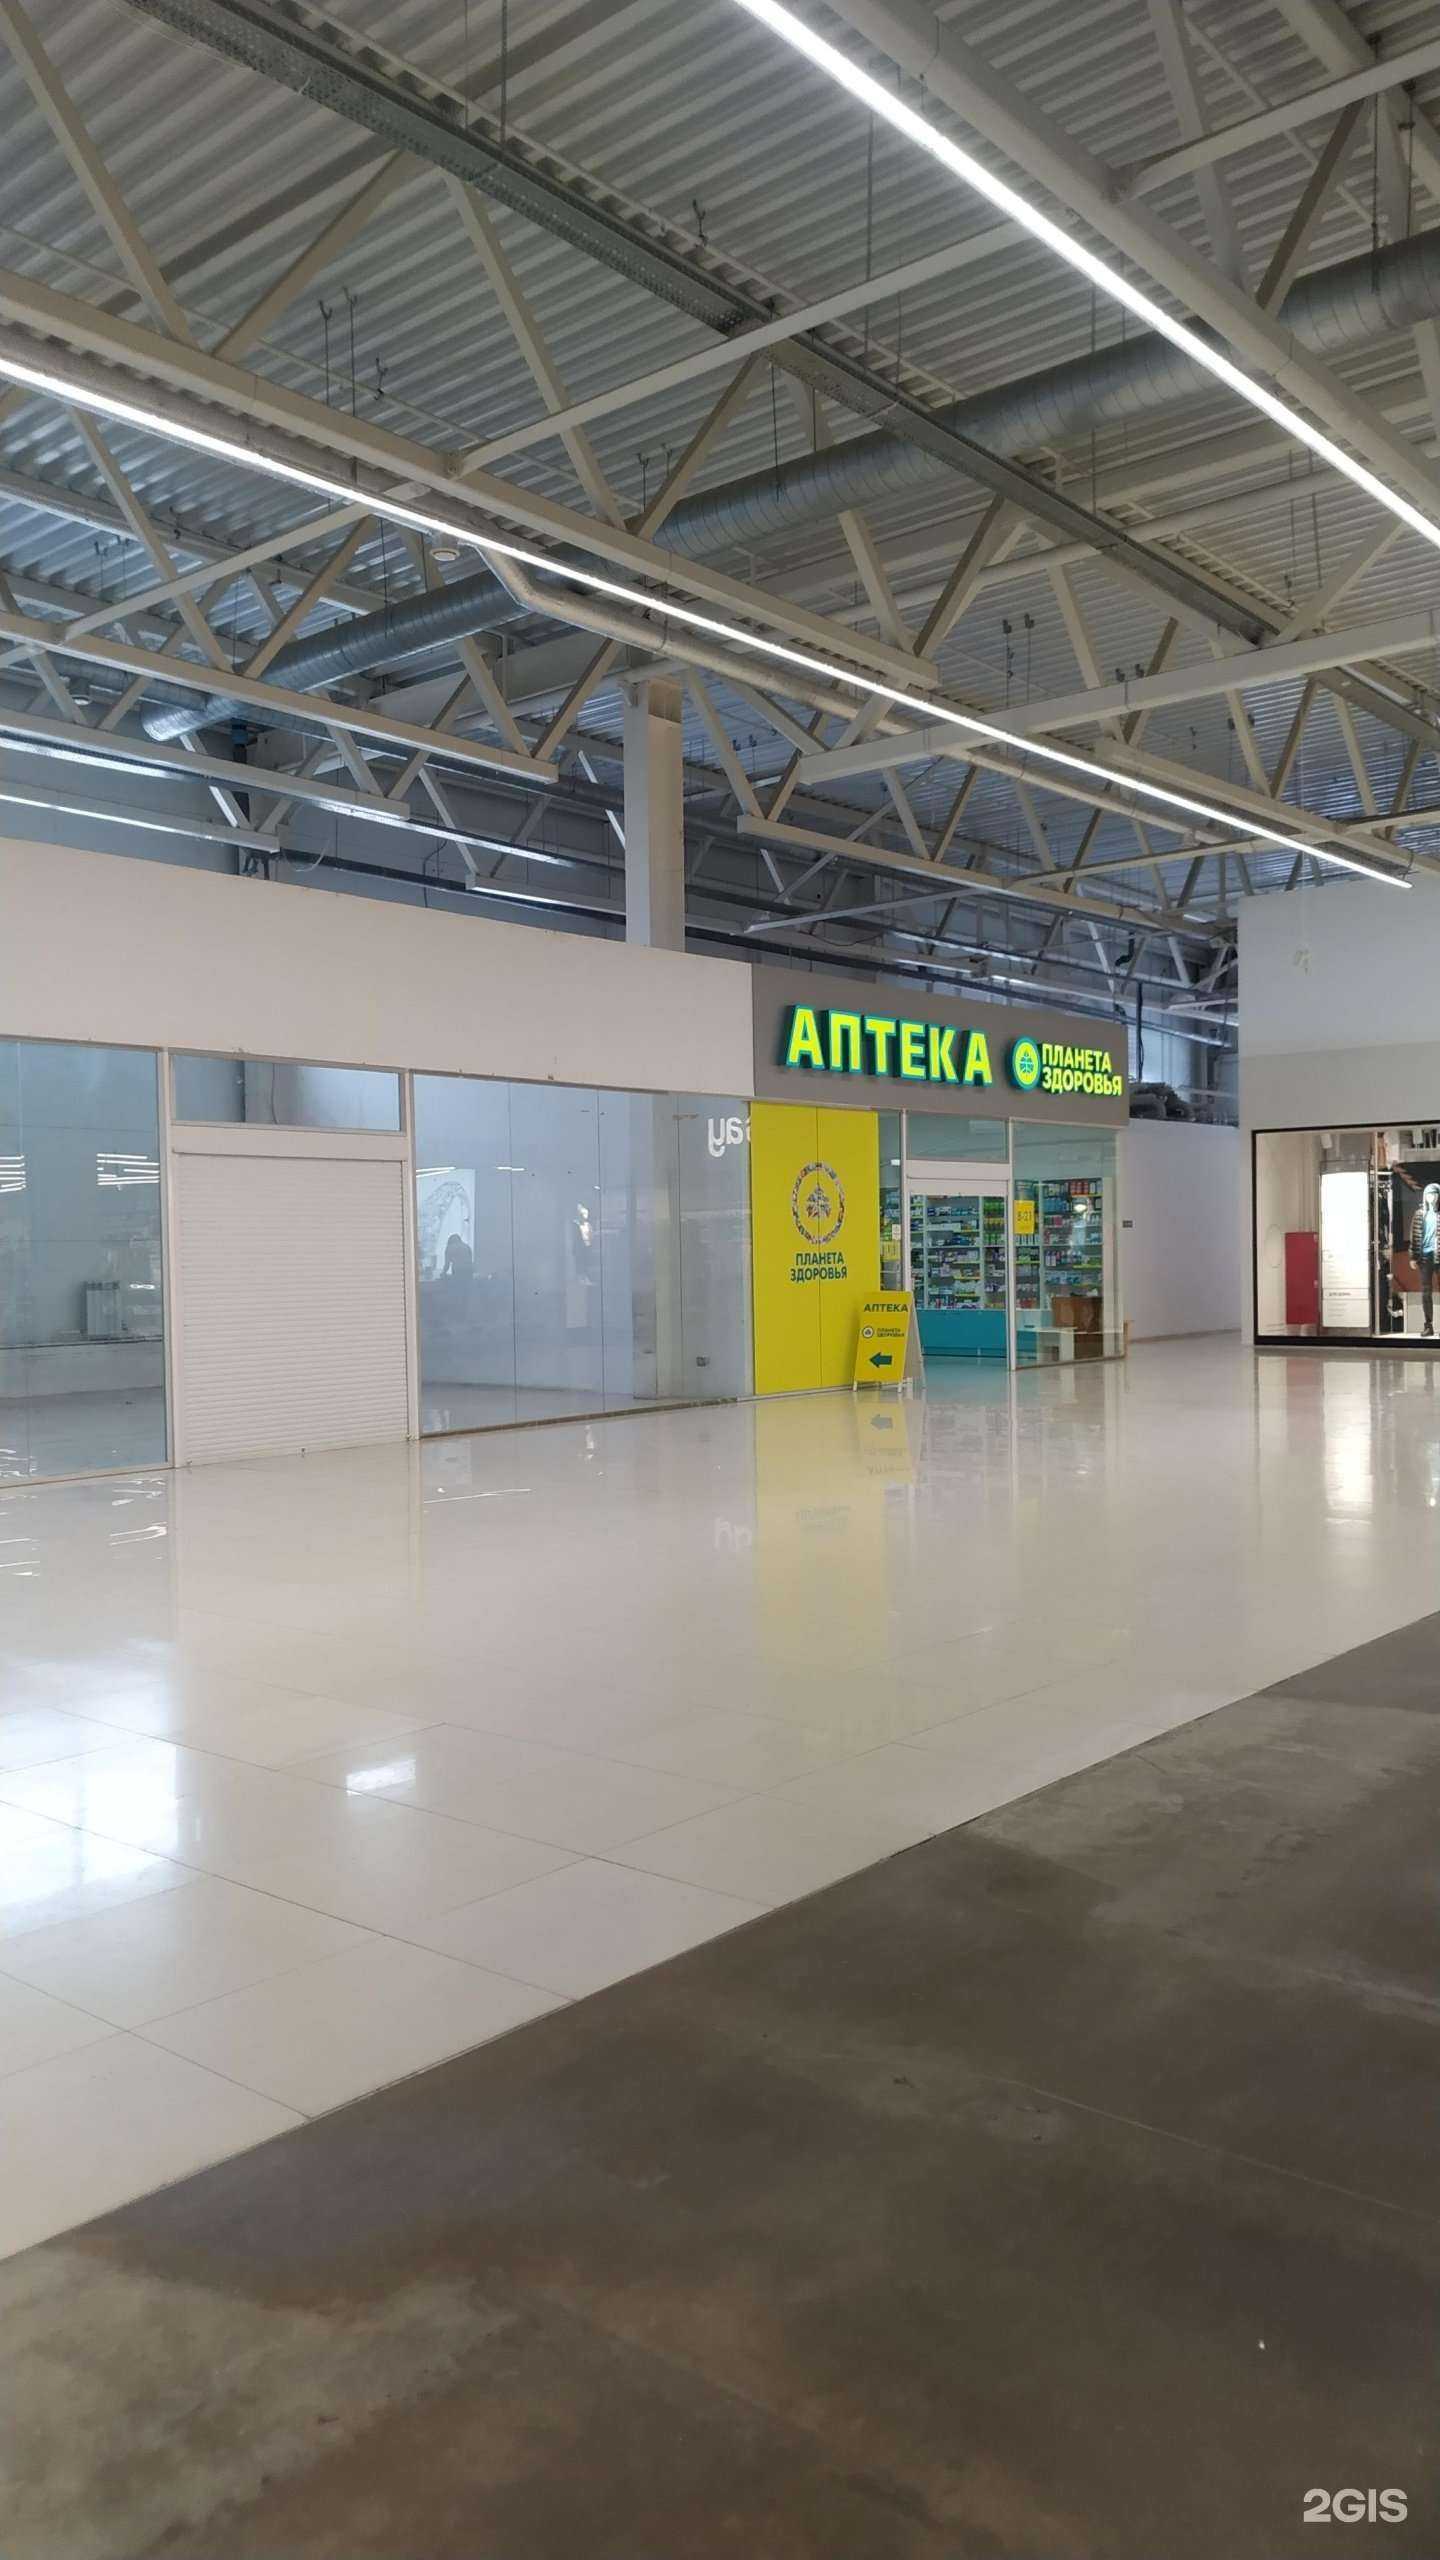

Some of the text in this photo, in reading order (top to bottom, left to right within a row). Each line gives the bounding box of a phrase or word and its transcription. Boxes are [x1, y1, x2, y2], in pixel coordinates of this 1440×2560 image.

[784, 1004, 993, 1088] АПТЕКА
[1041, 1043, 1112, 1073] ПЛАНЕТА
[1041, 1066, 1122, 1096] ЗДОРОВЬЯ
[795, 1252, 844, 1265] ПЛАНЕТА
[790, 1266, 847, 1282] ЗДОРОВЬЯ
[863, 1303, 909, 1313] АПТЕКА
